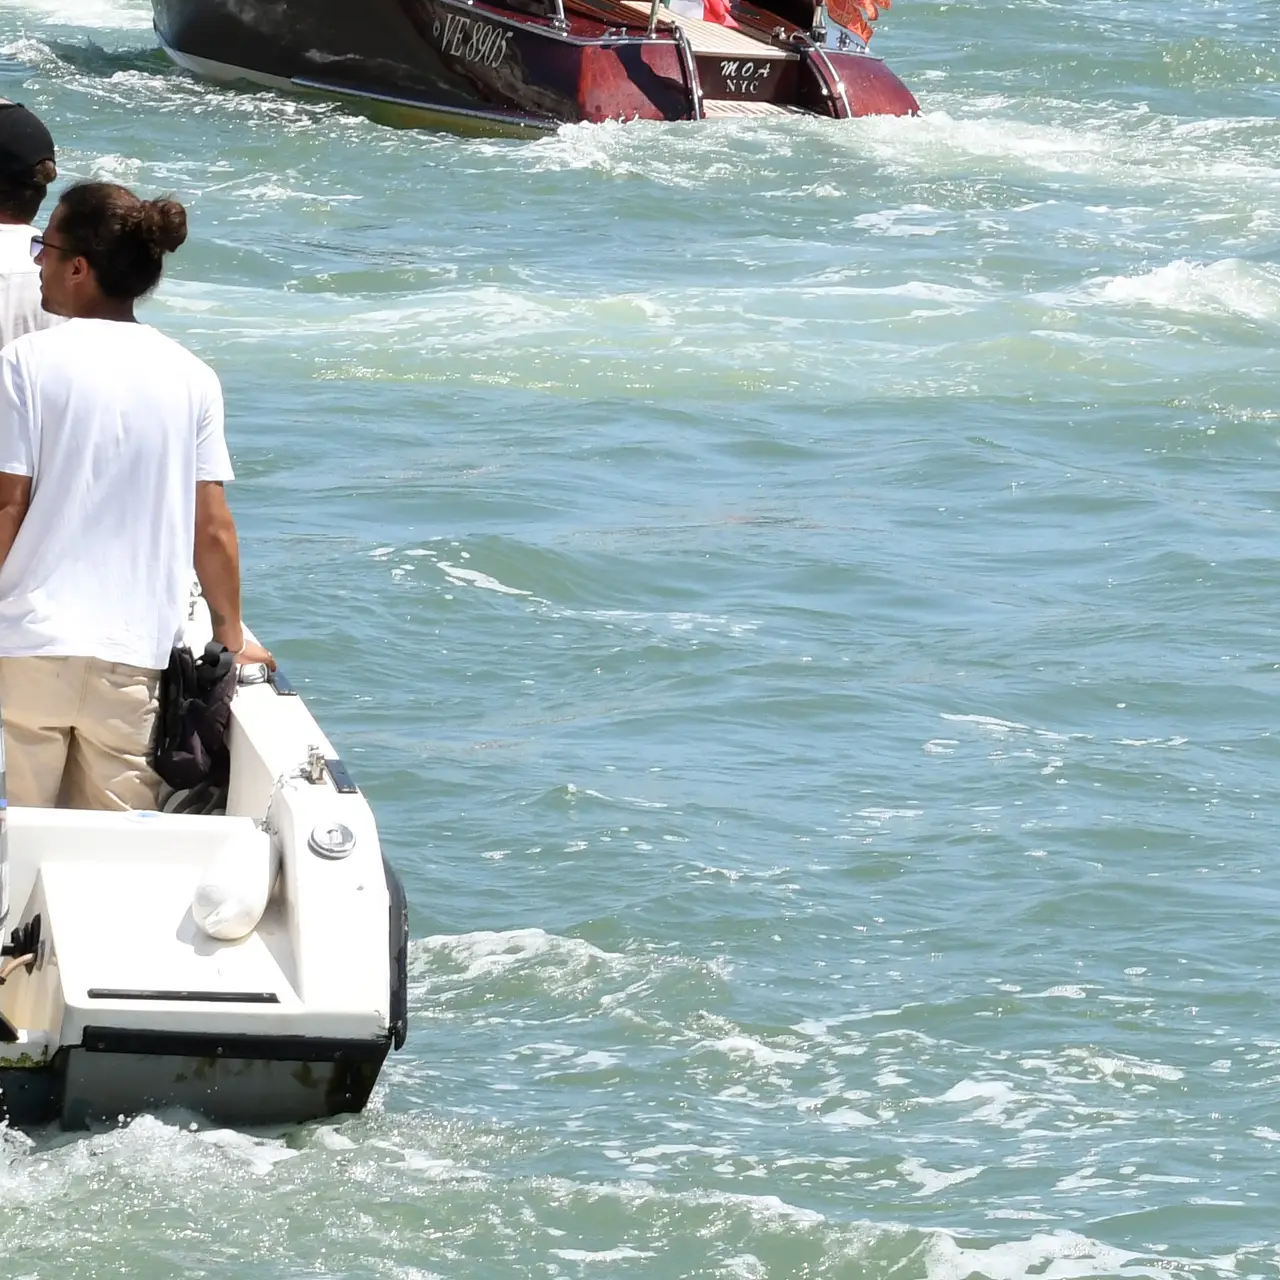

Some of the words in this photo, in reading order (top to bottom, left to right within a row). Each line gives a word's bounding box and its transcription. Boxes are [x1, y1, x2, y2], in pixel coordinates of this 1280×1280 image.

[441, 13, 471, 57] VE
[465, 21, 514, 68] 8905
[725, 78, 759, 94] NYC
